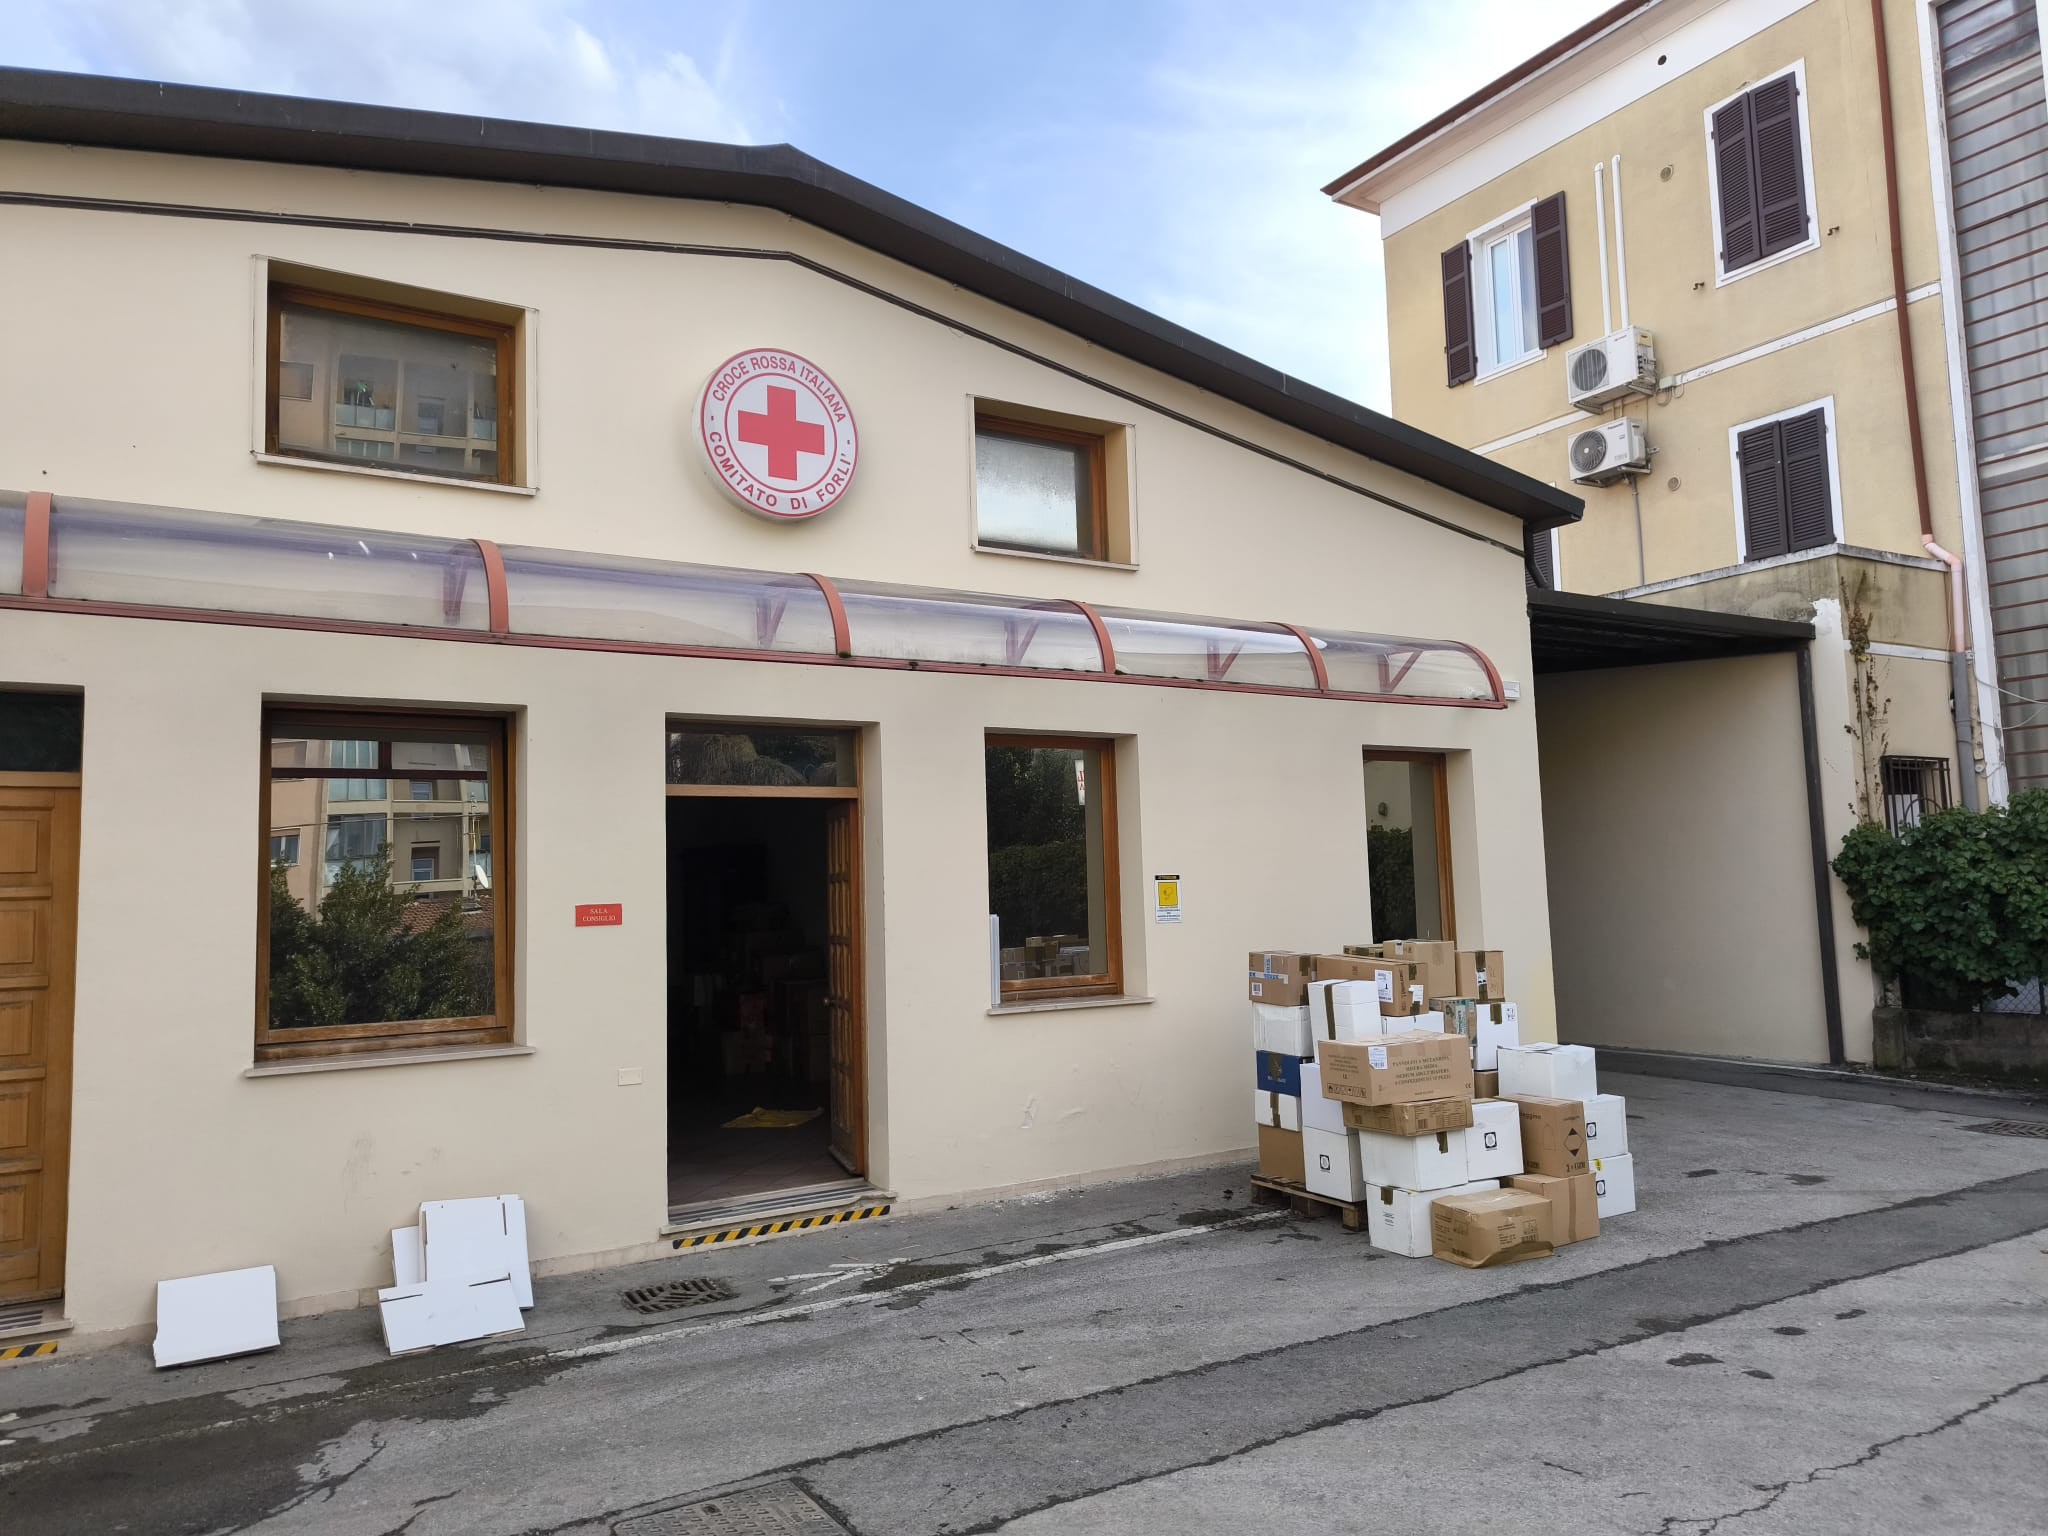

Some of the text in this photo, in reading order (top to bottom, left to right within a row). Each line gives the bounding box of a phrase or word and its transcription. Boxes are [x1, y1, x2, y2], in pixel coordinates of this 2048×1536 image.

[712, 355, 847, 423] CROCE ROSSA ITALIANA
[709, 431, 851, 510] COMITATO DI FORLI'
